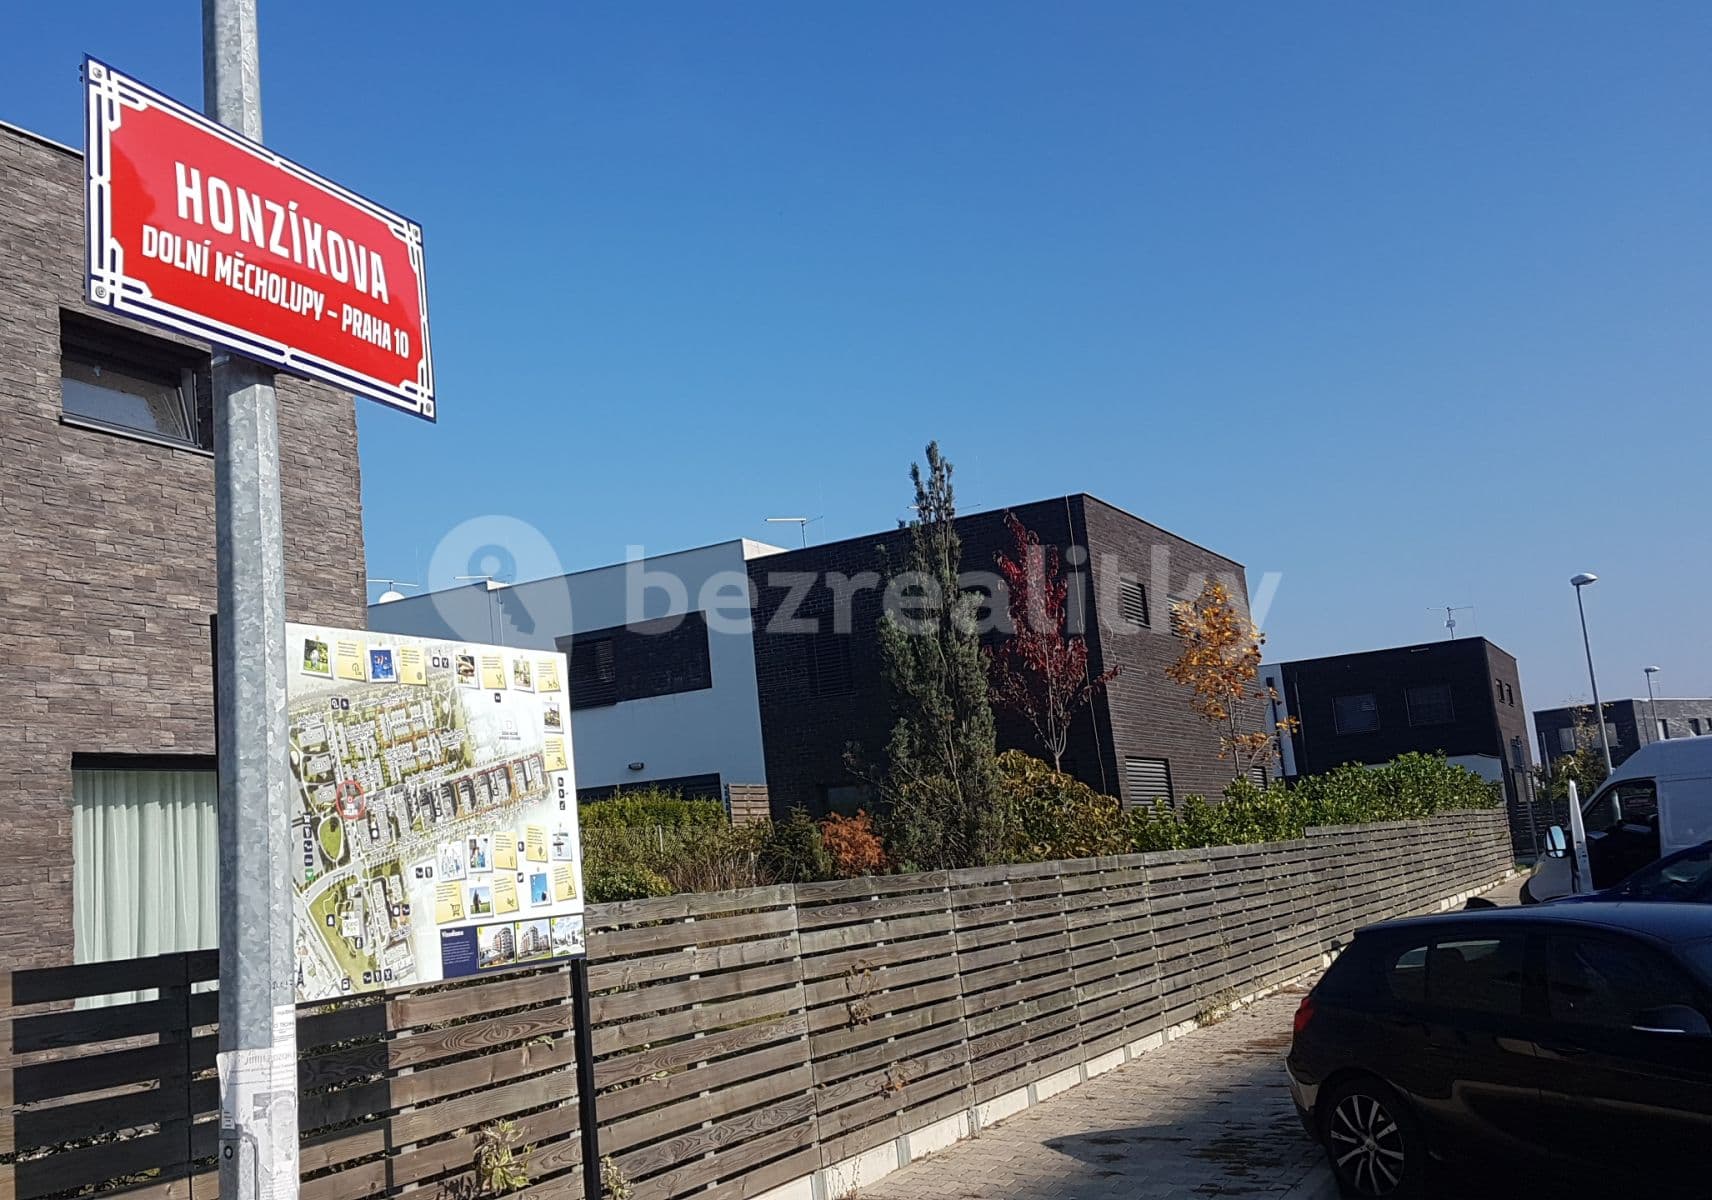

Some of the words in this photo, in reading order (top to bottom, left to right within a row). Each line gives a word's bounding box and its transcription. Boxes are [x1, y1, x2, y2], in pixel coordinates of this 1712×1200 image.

[142, 224, 212, 278] DOLNÍ
[214, 251, 325, 321] MĚCHOLUPY
[341, 303, 392, 352] PRAHA
[394, 327, 409, 359] 10
[175, 161, 389, 305] HONZÍKOVA
